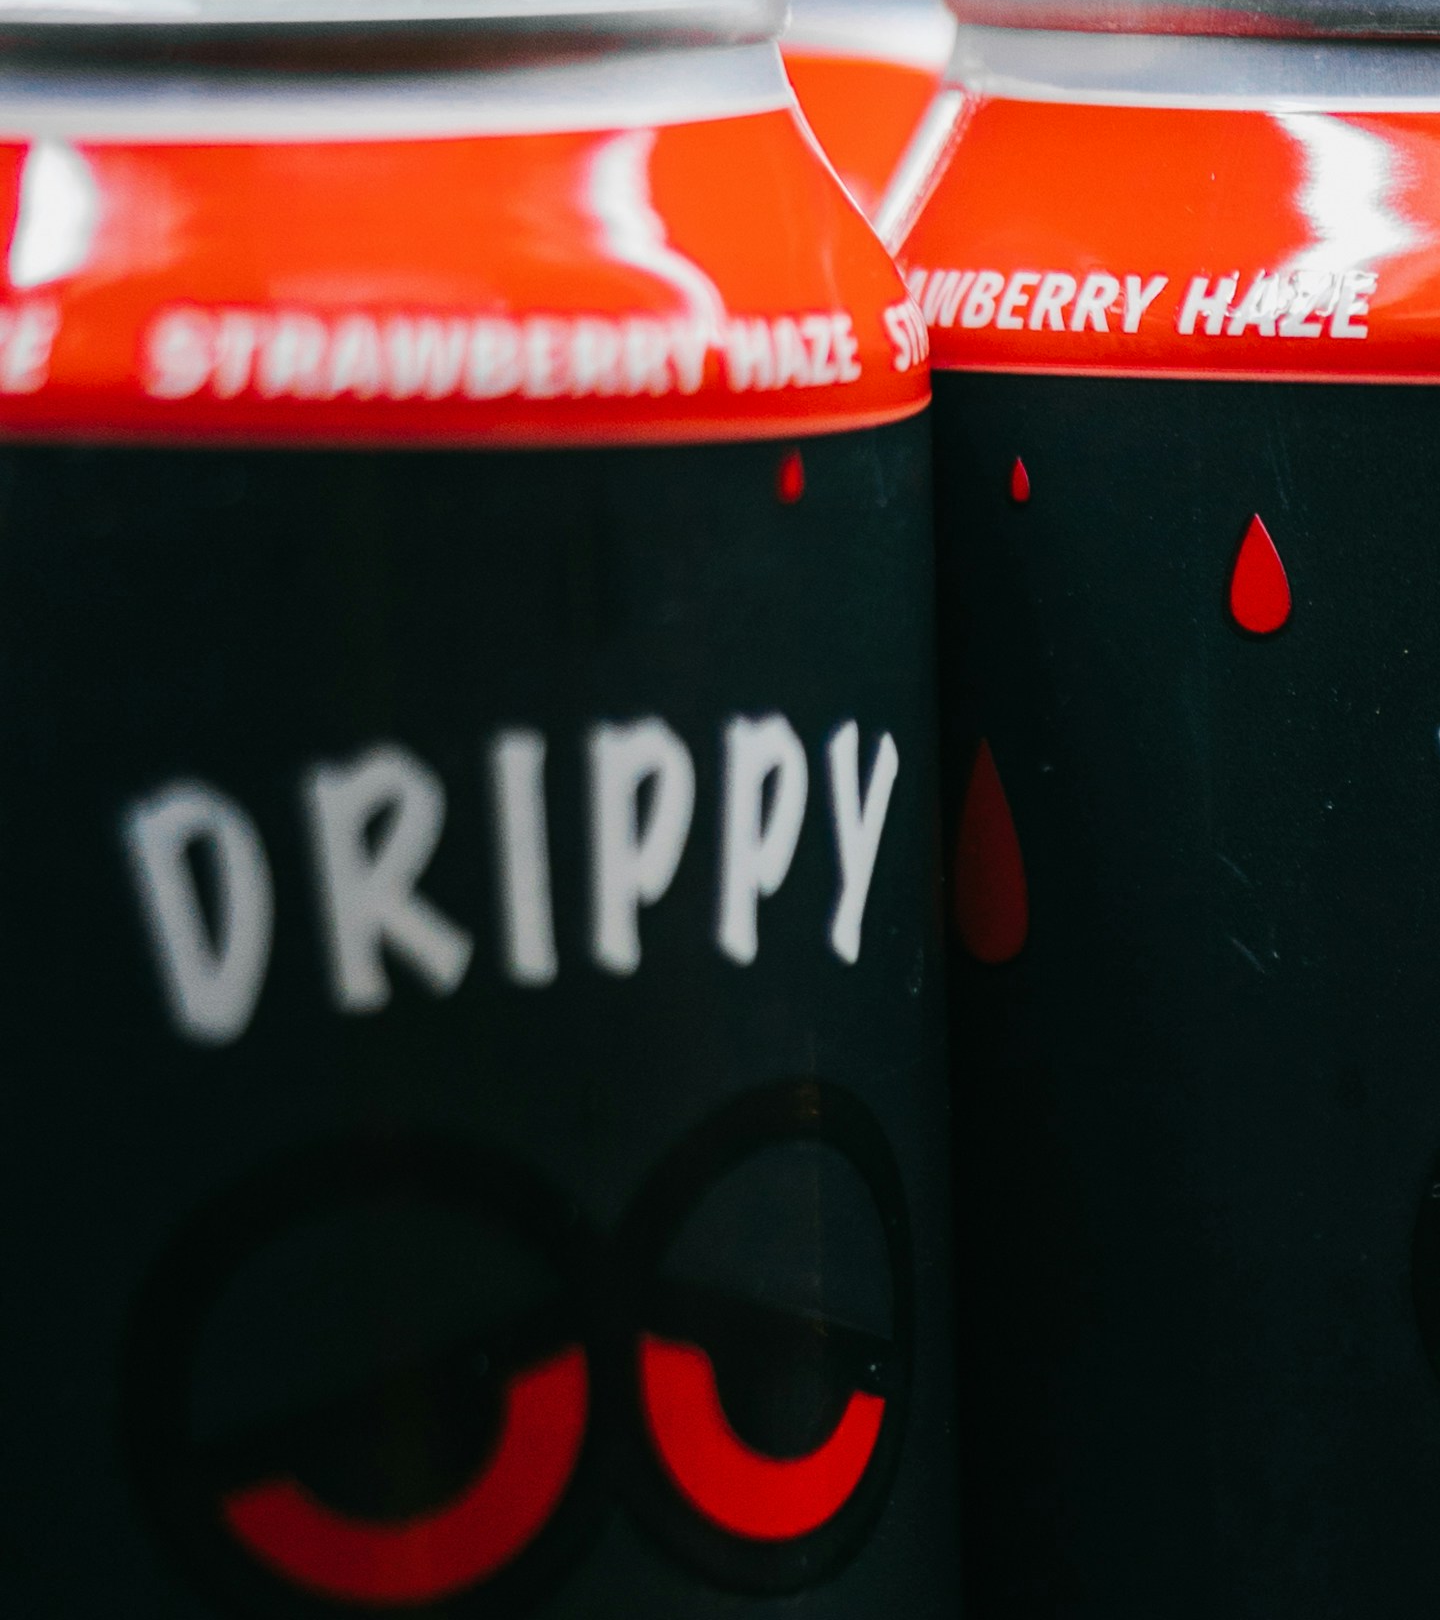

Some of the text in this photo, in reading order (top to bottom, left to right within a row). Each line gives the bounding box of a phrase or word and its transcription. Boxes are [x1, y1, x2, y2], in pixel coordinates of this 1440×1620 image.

[145, 306, 706, 400] STRAWBERRY
[728, 312, 864, 388] HAZE
[1178, 270, 1378, 342] HAZE
[122, 710, 900, 1048] DRIPPY
